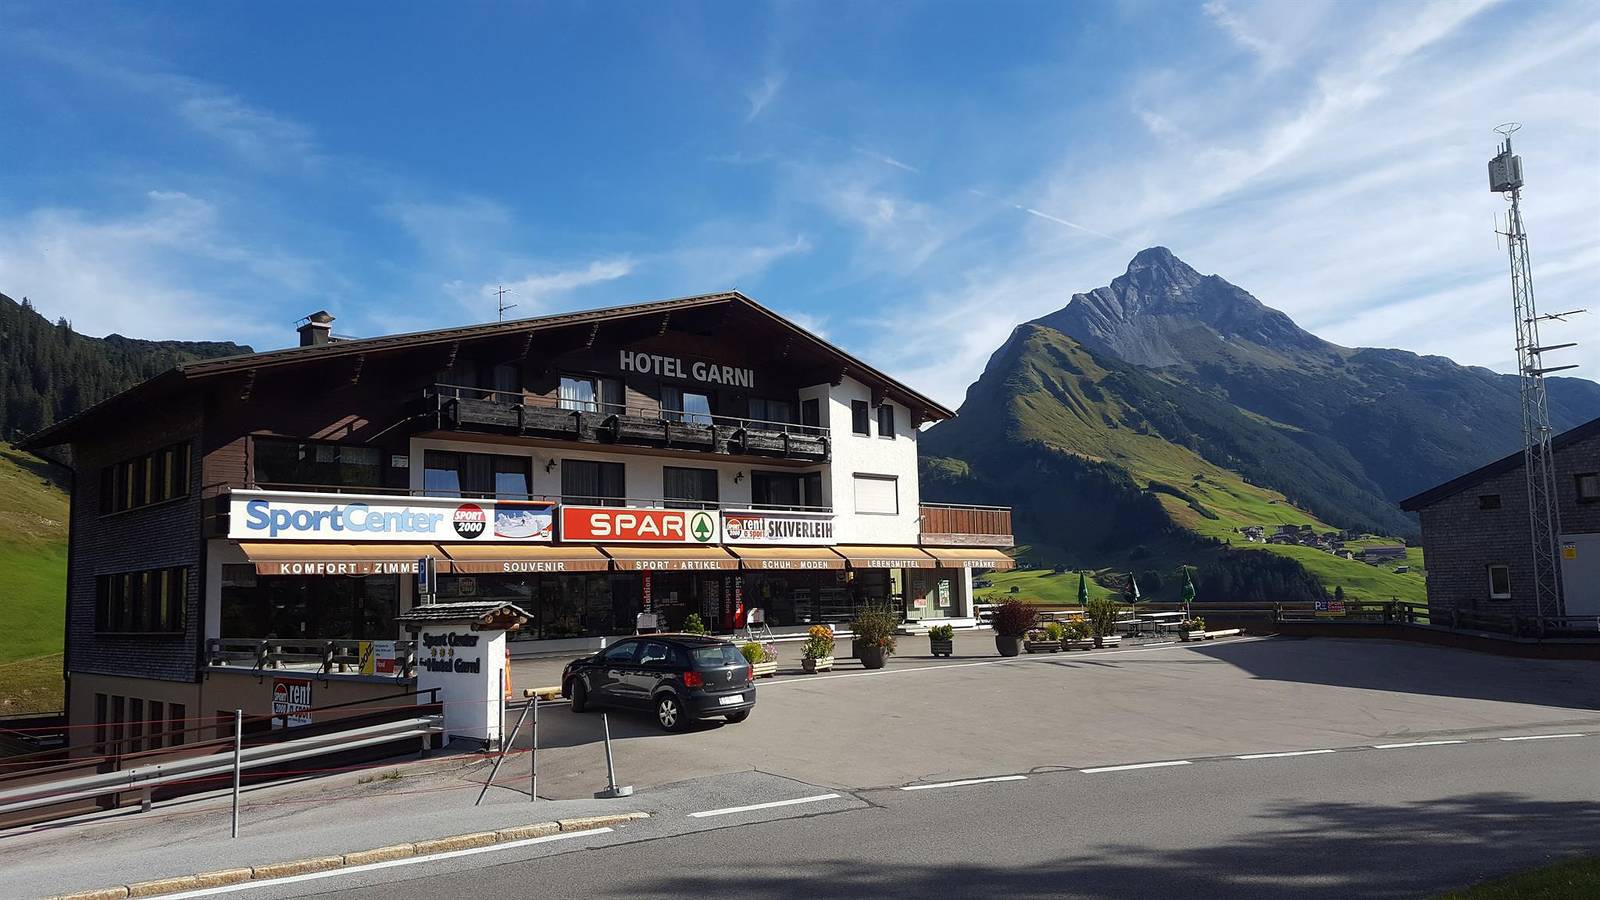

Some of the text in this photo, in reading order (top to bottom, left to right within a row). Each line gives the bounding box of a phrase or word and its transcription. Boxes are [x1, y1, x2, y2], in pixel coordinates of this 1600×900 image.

[620, 350, 754, 388] HOTEL GARNI
[246, 499, 444, 537] SportCenter
[455, 510, 483, 521] SPORT
[457, 522, 483, 532] 2000
[590, 513, 684, 537] SPAR
[743, 518, 764, 530] rent
[768, 520, 833, 538] SKIVERLEIH
[281, 563, 357, 573] KOMFORT
[374, 563, 420, 573] ZIMME
[503, 562, 566, 572] SOUVENIR
[635, 561, 669, 570] SPORT
[681, 561, 721, 569] ARTIKEL
[762, 560, 791, 569] SCHUH
[800, 561, 828, 569] MODEN
[867, 560, 920, 568] LEBENSMITTEL
[963, 559, 996, 568] GETRÄNKE
[422, 632, 480, 649] Sport Center
[454, 657, 481, 674] Garni
[289, 681, 311, 705] rent
